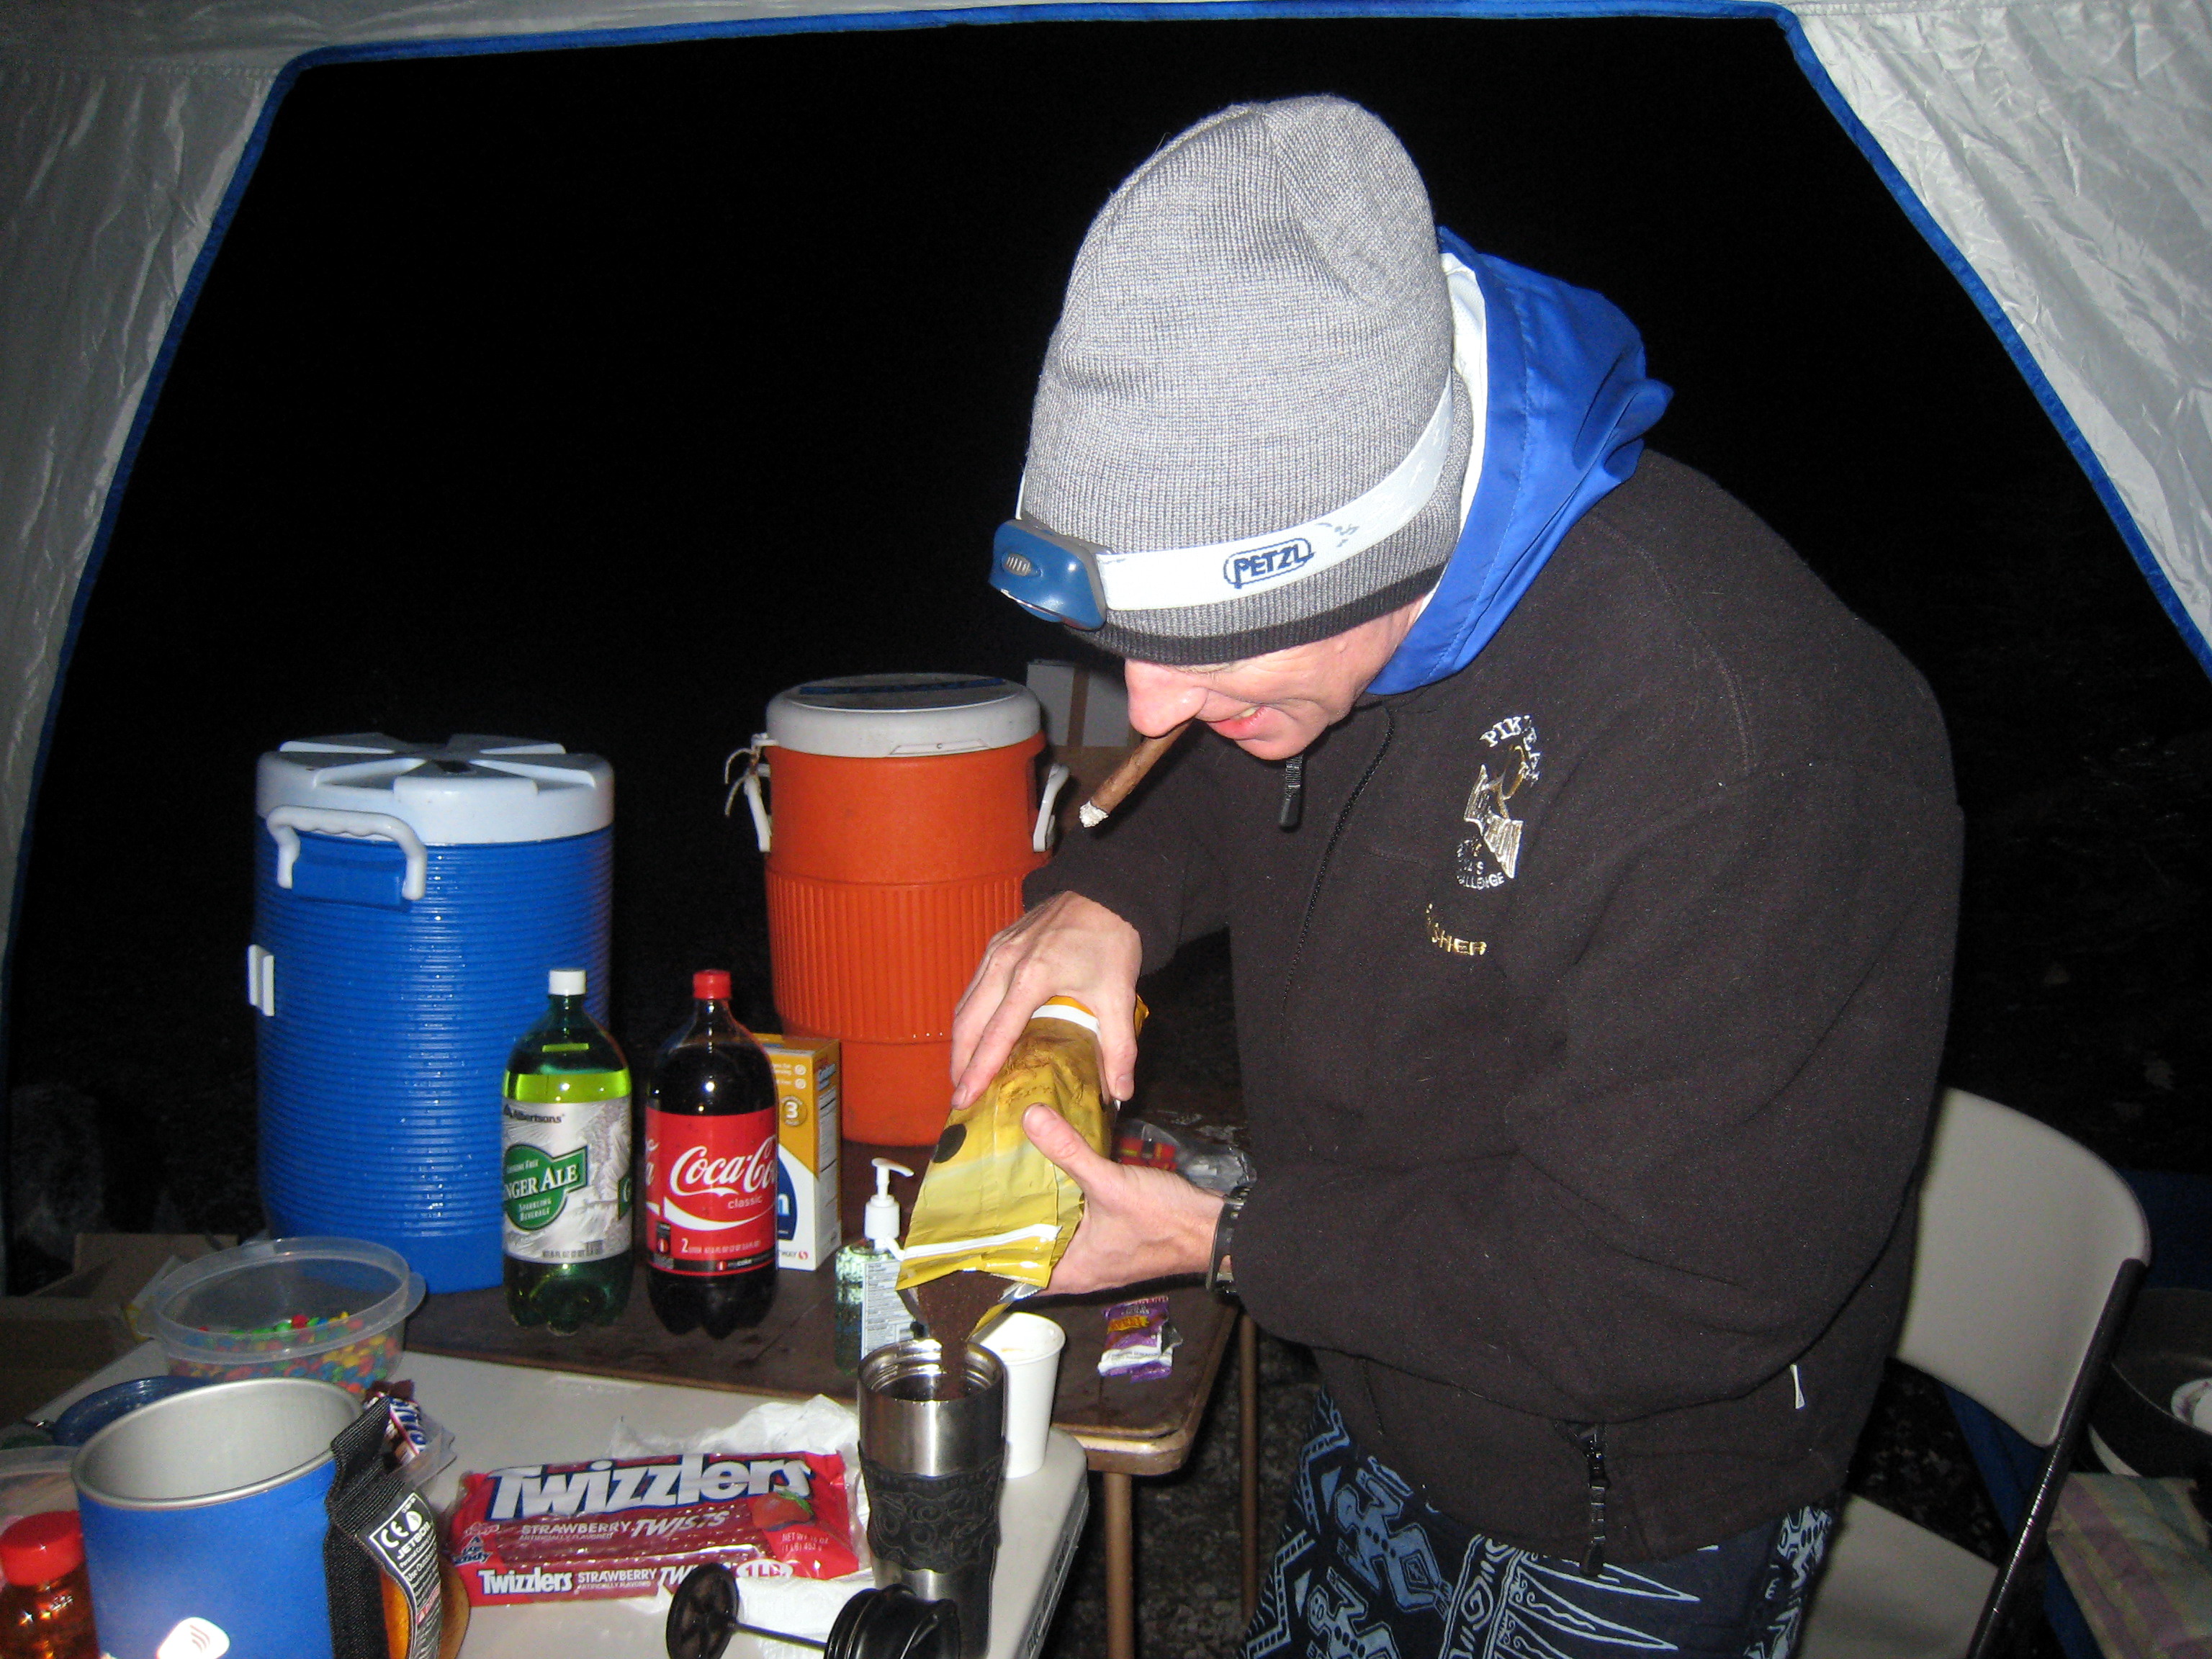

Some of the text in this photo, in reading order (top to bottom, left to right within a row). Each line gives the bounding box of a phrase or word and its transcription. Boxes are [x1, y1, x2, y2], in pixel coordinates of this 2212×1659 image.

[1234, 544, 1316, 589] PETZL
[786, 1101, 799, 1119] 3
[541, 1164, 578, 1192] ALE
[727, 1195, 763, 1209] classic
[680, 1237, 689, 1253] 2
[487, 1453, 812, 1519] Twizzlers
[521, 1520, 628, 1535] STRAWBERRY
[631, 1510, 730, 1538] TWISTS
[782, 1532, 795, 1542] NET
[477, 1565, 574, 1595] Twizzlers
[577, 1568, 657, 1584] STRAWBERRY
